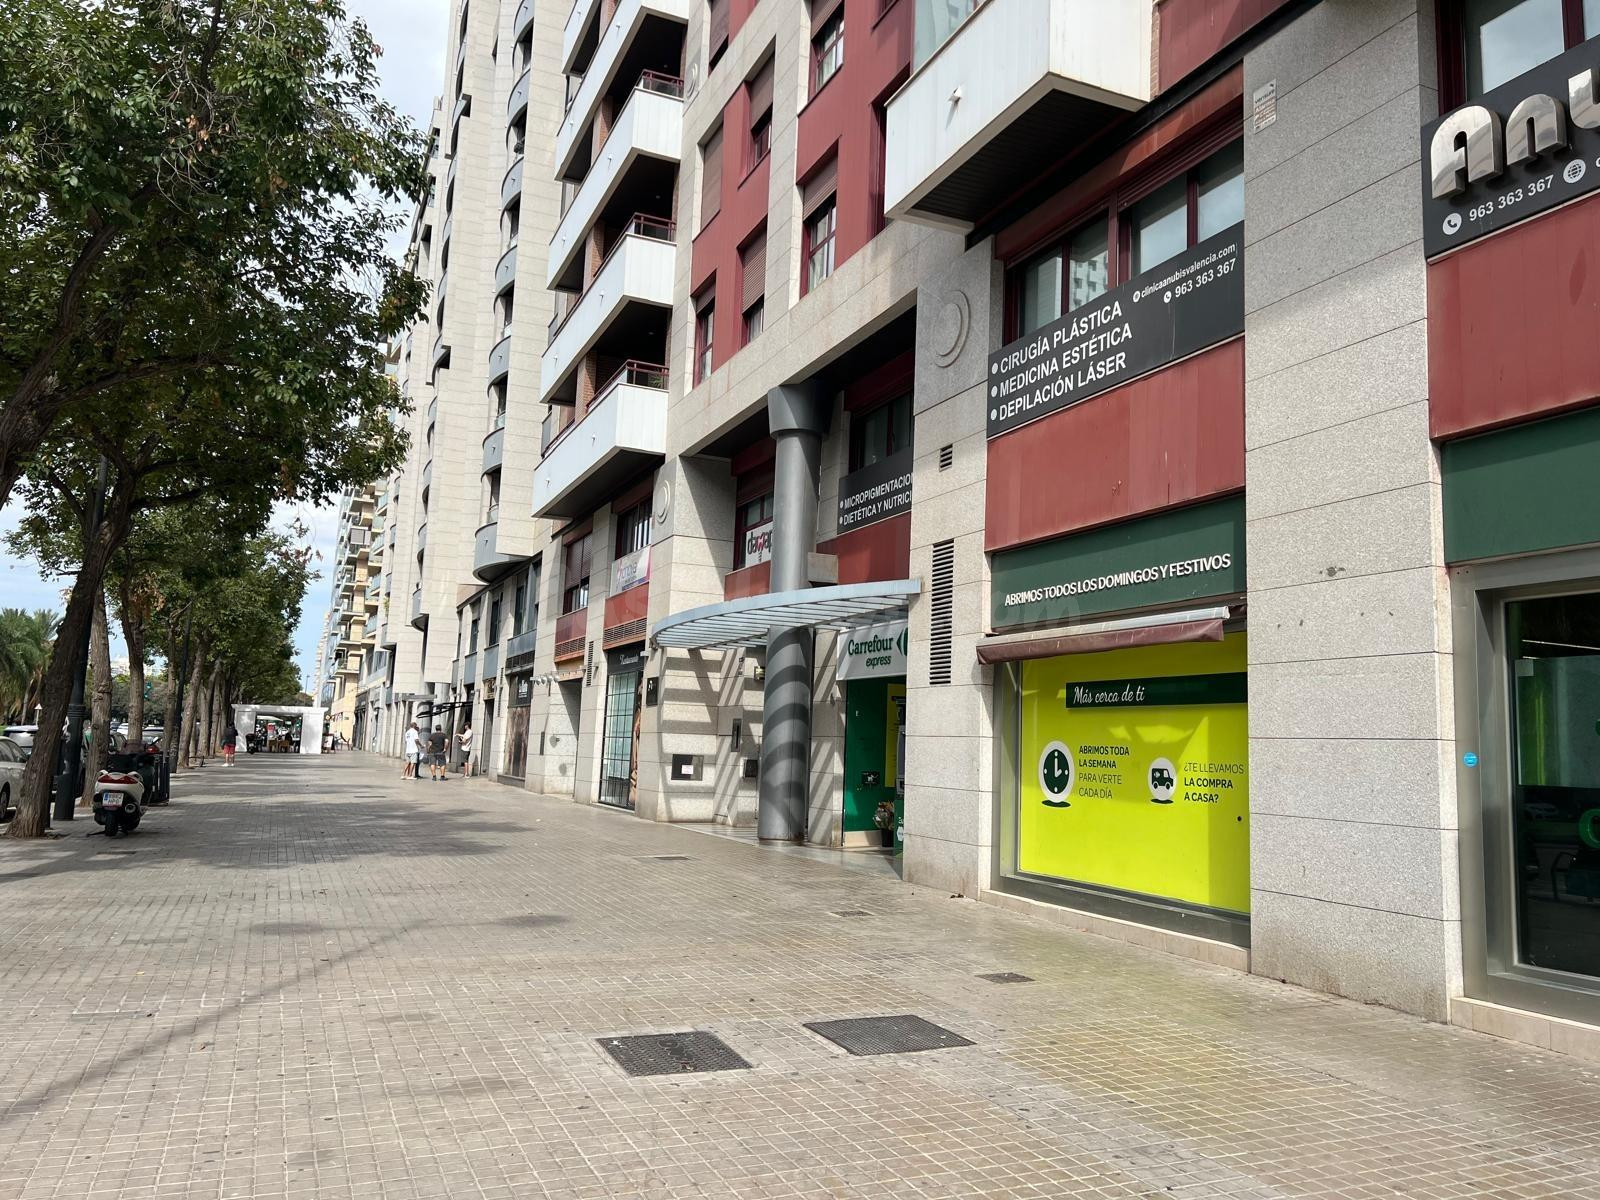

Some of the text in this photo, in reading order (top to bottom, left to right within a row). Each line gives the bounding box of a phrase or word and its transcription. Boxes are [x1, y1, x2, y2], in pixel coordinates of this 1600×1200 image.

[1469, 174, 1554, 221] 963 363 367
[1141, 243, 1236, 298] clinicaanubisvalencia.com
[1175, 257, 1236, 298] 963 363 367
[1000, 300, 1122, 373] CIRUGÍA PLÁSTICA
[1000, 323, 1132, 398] MEDICINA ESTÉTICA
[1000, 352, 1126, 421] DEPILACIÓN LÁSER
[843, 506, 877, 526] DIETÉTICA
[877, 501, 883, 513] Y
[1004, 553, 1231, 606] ABRIMOS TODOS LOS DOMINGOS Y FESTIVOS
[848, 634, 894, 656] Carrefour
[865, 655, 892, 669] express
[1073, 683, 1146, 704] Más cerca de ti
[1078, 745, 1130, 756] ABRIMOS TODA
[1078, 759, 1117, 769] LA SEMANA
[1184, 762, 1244, 774] ¿TE LLEVAMOS
[1078, 772, 1122, 785] PARA VERTE
[1184, 777, 1233, 789] LA COMPRA
[1078, 786, 1113, 799] CADA DÍA
[1184, 792, 1219, 803] A CASA?
